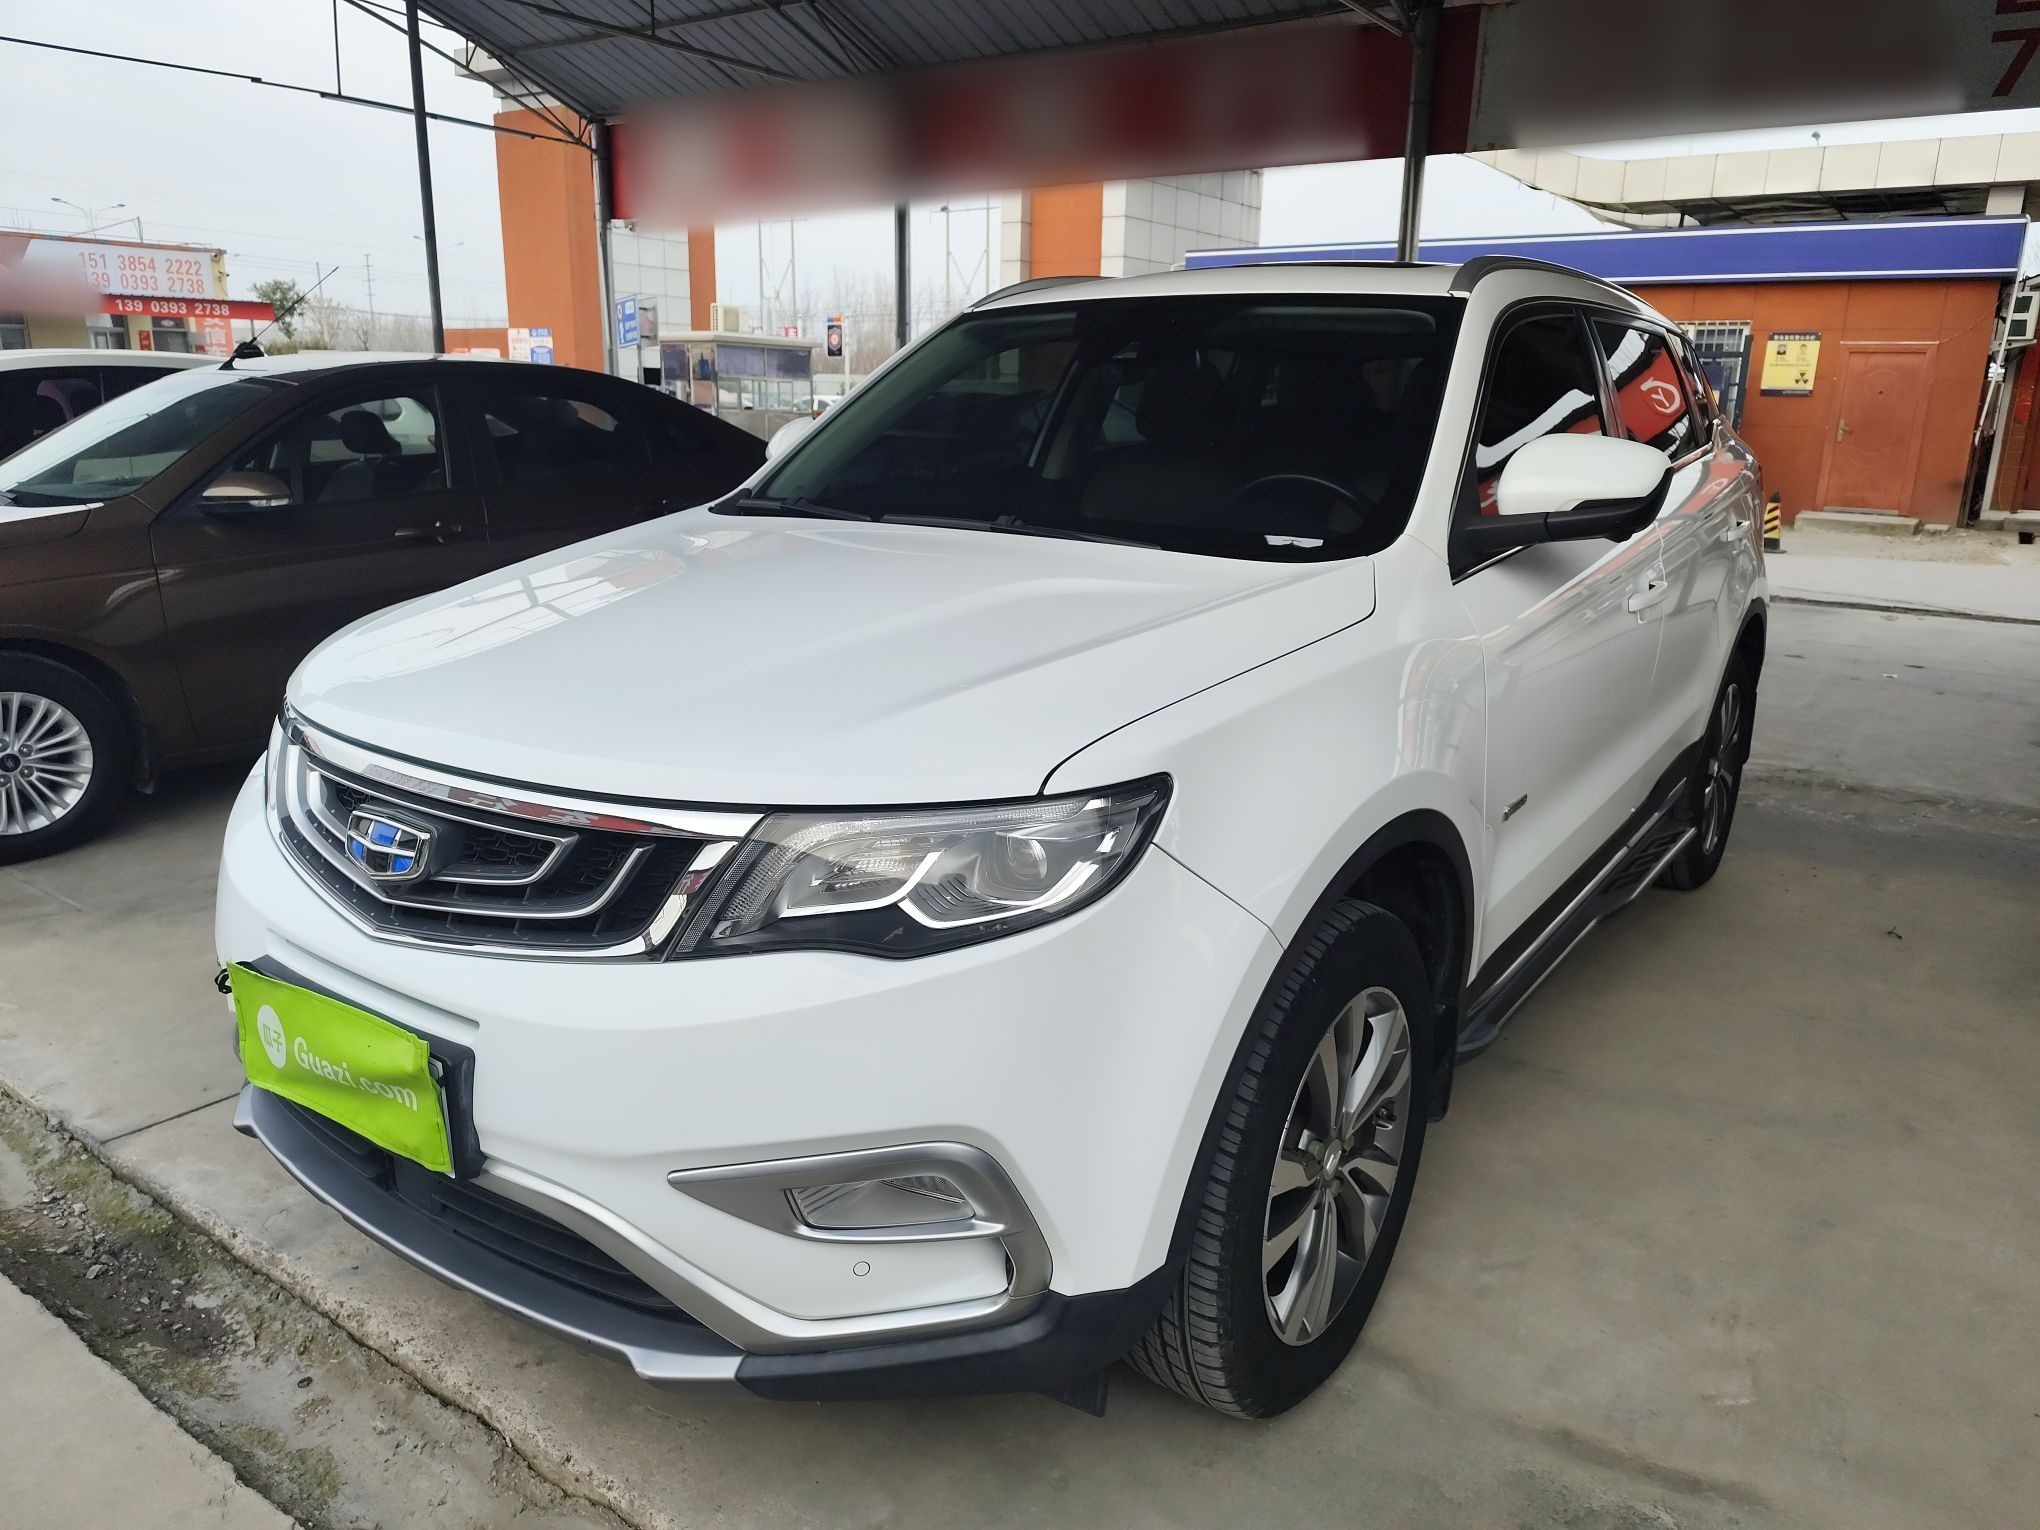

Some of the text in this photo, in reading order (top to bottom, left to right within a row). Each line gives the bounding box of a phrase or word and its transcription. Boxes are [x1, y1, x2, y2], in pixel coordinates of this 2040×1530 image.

[79, 252, 203, 276] 151 3854 2222
[121, 274, 159, 291] 0393
[168, 277, 205, 294] 2738
[115, 299, 230, 316] 139 0393 2738
[294, 1037, 417, 1111] Guazi.com
